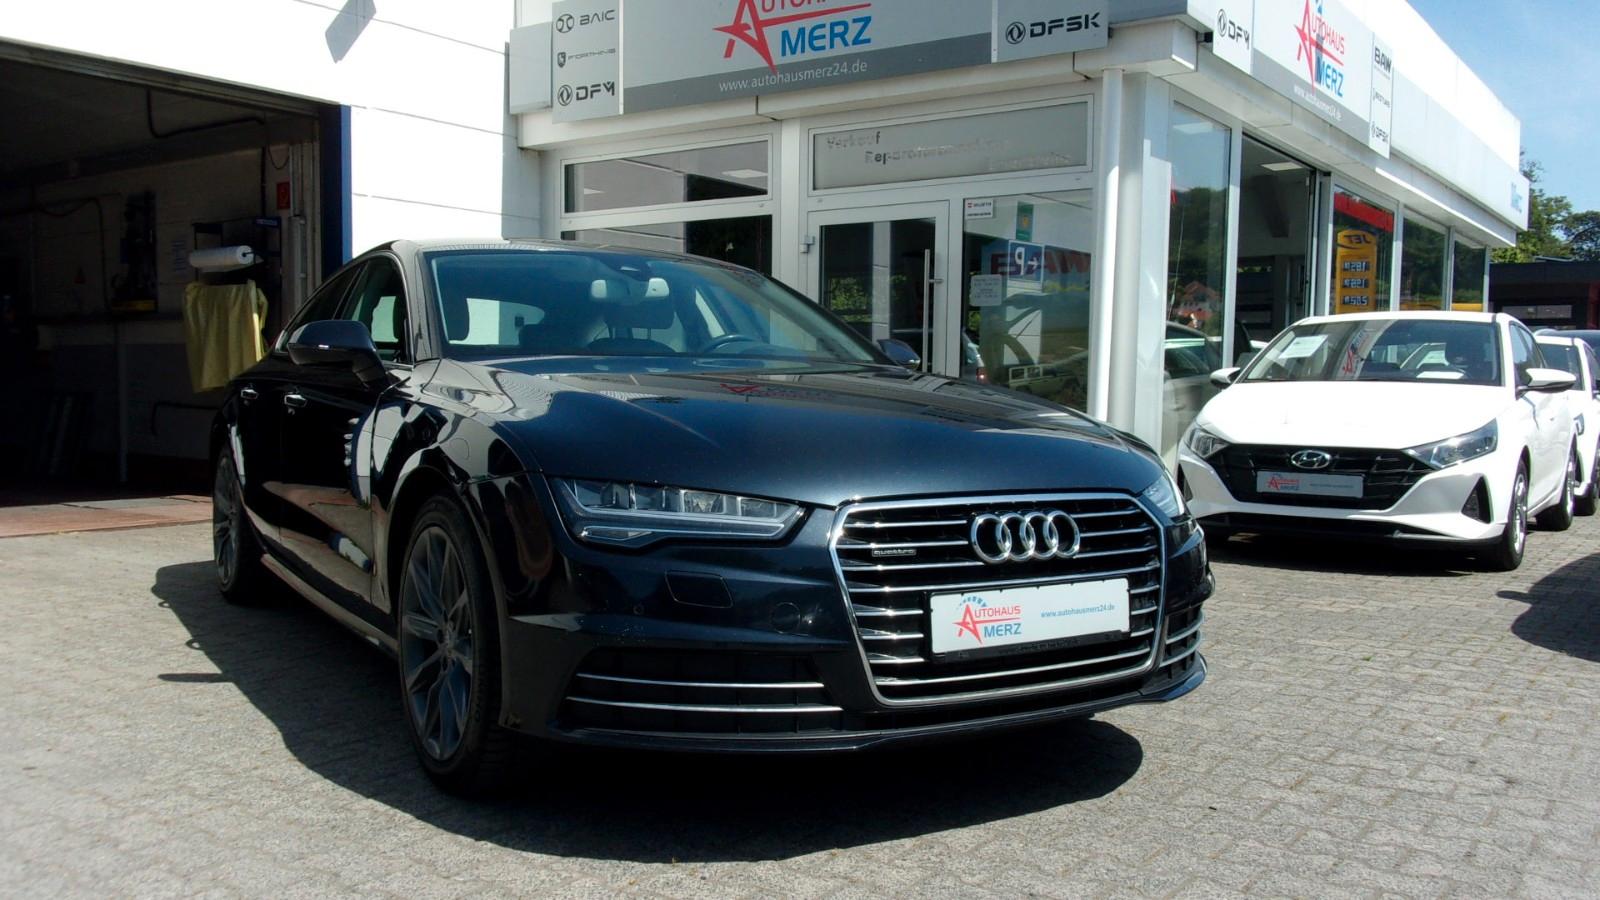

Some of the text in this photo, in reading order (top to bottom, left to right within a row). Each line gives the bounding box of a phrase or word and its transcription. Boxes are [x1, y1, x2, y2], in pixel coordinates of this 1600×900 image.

[579, 9, 615, 26] BAIC
[1029, 12, 1100, 38] DFSK
[781, 16, 872, 57] MERZ
[1374, 46, 1392, 73] BAW
[719, 59, 868, 92] www.autohausmerz24.de
[1315, 56, 1344, 98] MERZ
[953, 604, 1022, 640] AUTOHAUS
[1040, 603, 1116, 618] www.autohausmerz24.de
[983, 623, 1022, 638] MERZ
